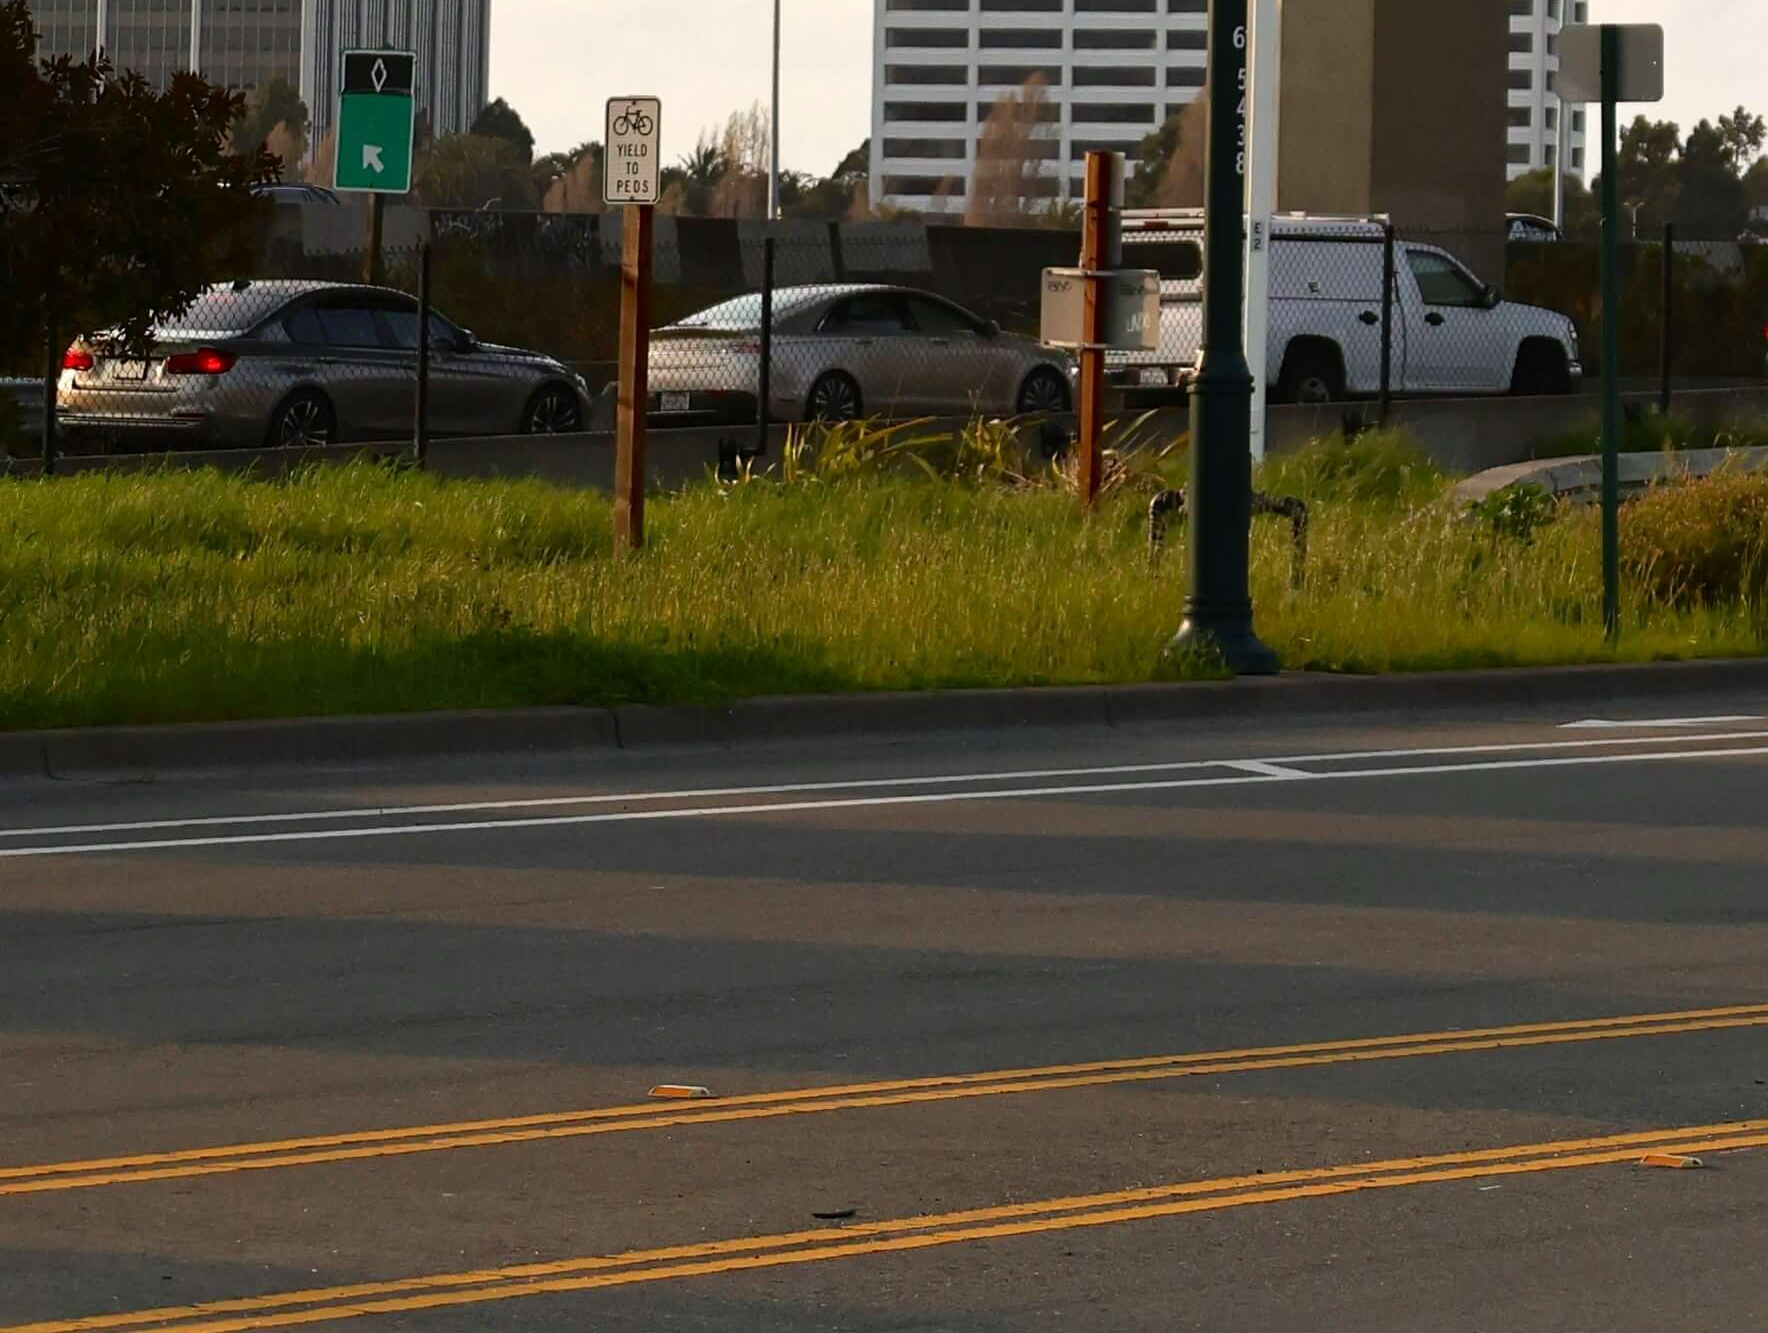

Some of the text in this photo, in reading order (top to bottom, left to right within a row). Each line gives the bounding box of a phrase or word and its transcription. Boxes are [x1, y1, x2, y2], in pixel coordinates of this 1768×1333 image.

[617, 143, 648, 157] YIELD
[626, 161, 639, 174] TO
[617, 179, 649, 193] PEDS
